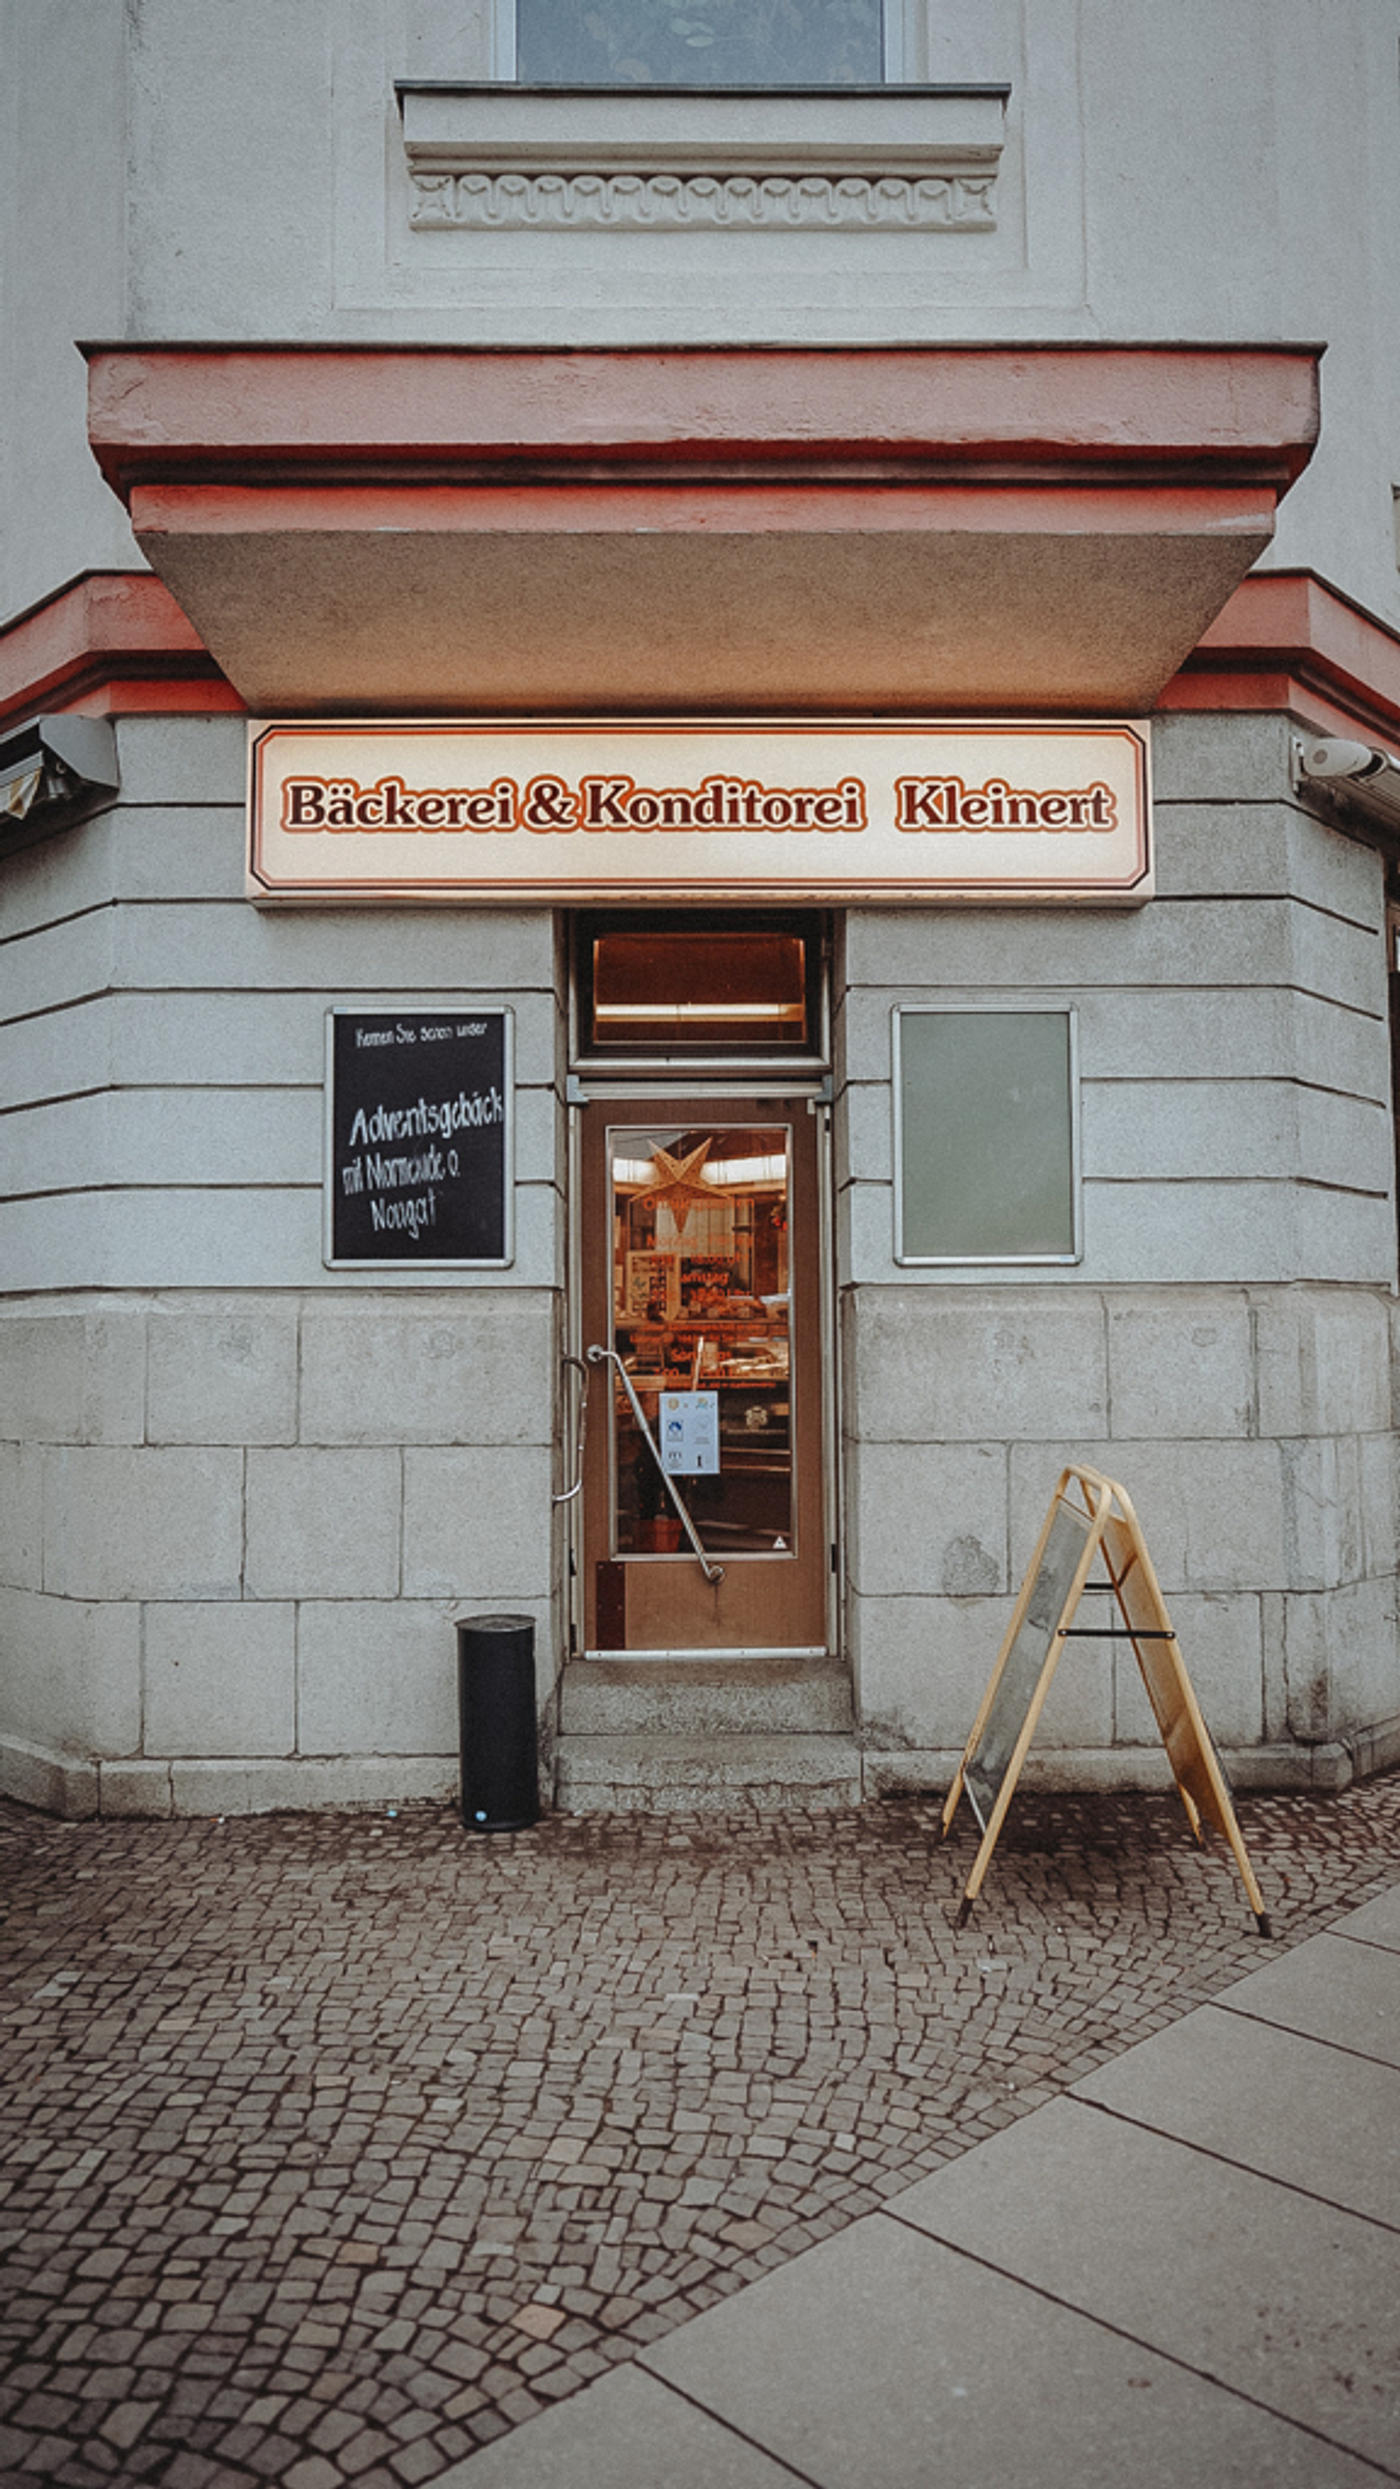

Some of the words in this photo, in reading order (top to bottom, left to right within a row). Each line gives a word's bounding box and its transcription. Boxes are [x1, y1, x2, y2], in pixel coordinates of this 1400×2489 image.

[286, 781, 517, 828] Bäckerei
[525, 781, 578, 828] &
[585, 780, 864, 828] Konditorei
[900, 781, 1111, 828] Kleinert
[349, 1086, 504, 1147] Adventsgebäck
[342, 1156, 364, 1196] mit
[370, 1187, 437, 1241] Nougat
